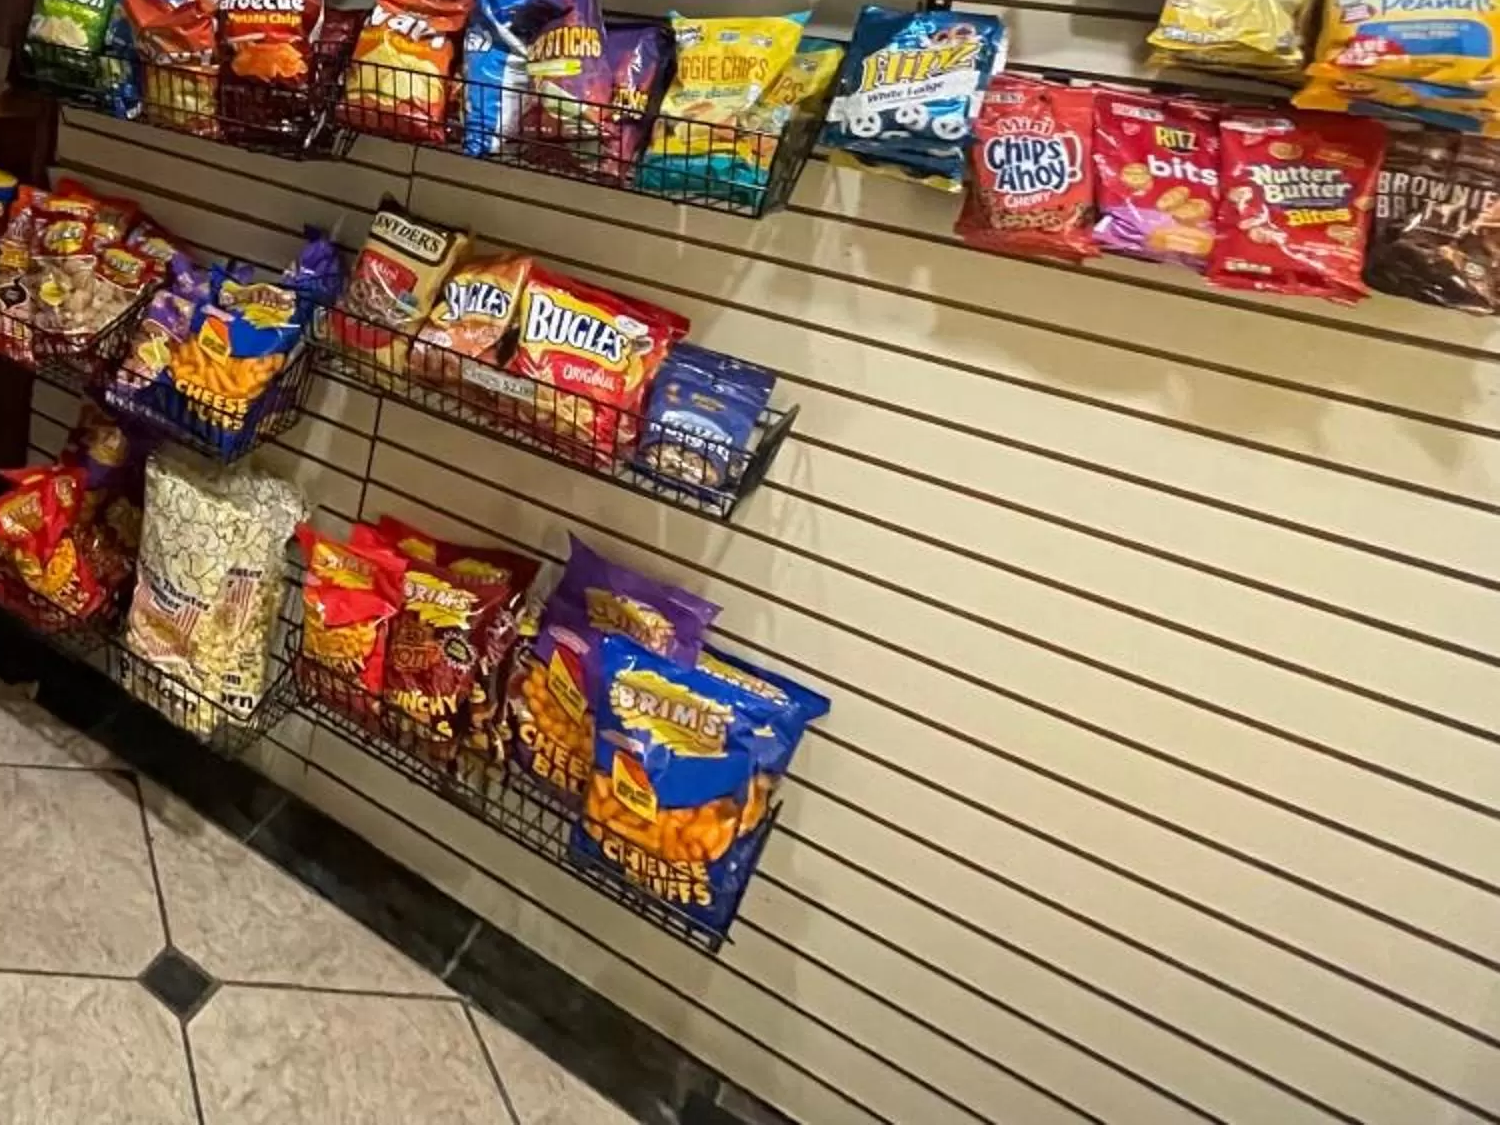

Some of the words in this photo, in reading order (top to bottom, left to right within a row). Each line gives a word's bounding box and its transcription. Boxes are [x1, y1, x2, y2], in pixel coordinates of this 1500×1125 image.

[545, 26, 601, 58] STICKS
[720, 54, 770, 82] CHIPS
[861, 37, 982, 92] Flipz
[986, 137, 1062, 170] Chips
[1155, 125, 1198, 150] RITZ
[1146, 154, 1219, 186] bits
[1249, 163, 1342, 187] Nutter
[1262, 182, 1351, 204] Butter
[1376, 170, 1499, 212] BROWNIE
[1284, 207, 1350, 226] Bites
[525, 295, 628, 364] BUGLES
[563, 365, 615, 392] ORIGINAL
[175, 377, 249, 415] CHEESE
[618, 684, 726, 737] BRIM'S
[602, 837, 709, 878] CHEESE
